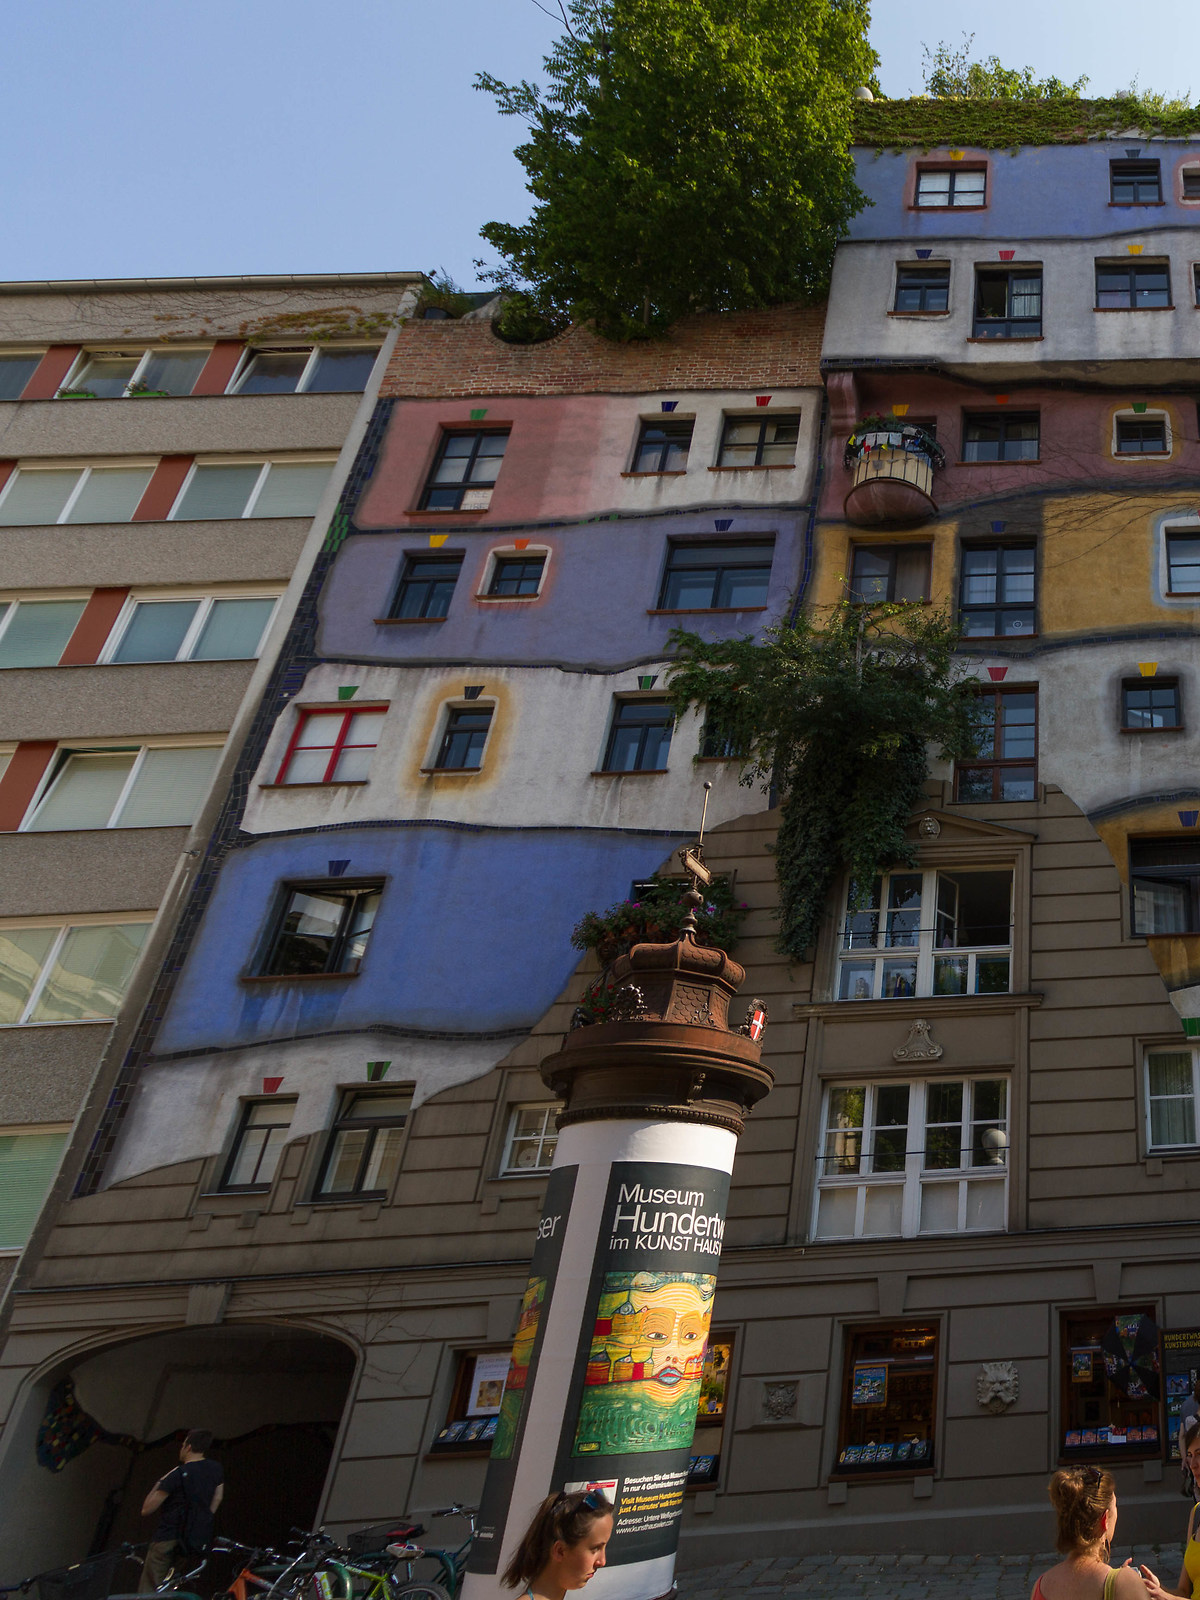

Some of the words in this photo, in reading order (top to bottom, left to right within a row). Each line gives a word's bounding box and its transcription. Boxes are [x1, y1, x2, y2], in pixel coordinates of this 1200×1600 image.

[617, 1183, 704, 1207] Museum
[537, 1215, 562, 1240] ser
[609, 1235, 629, 1250] im
[635, 1234, 692, 1251] KUNST
[621, 1497, 635, 1505] Visit
[636, 1495, 658, 1503] Museum
